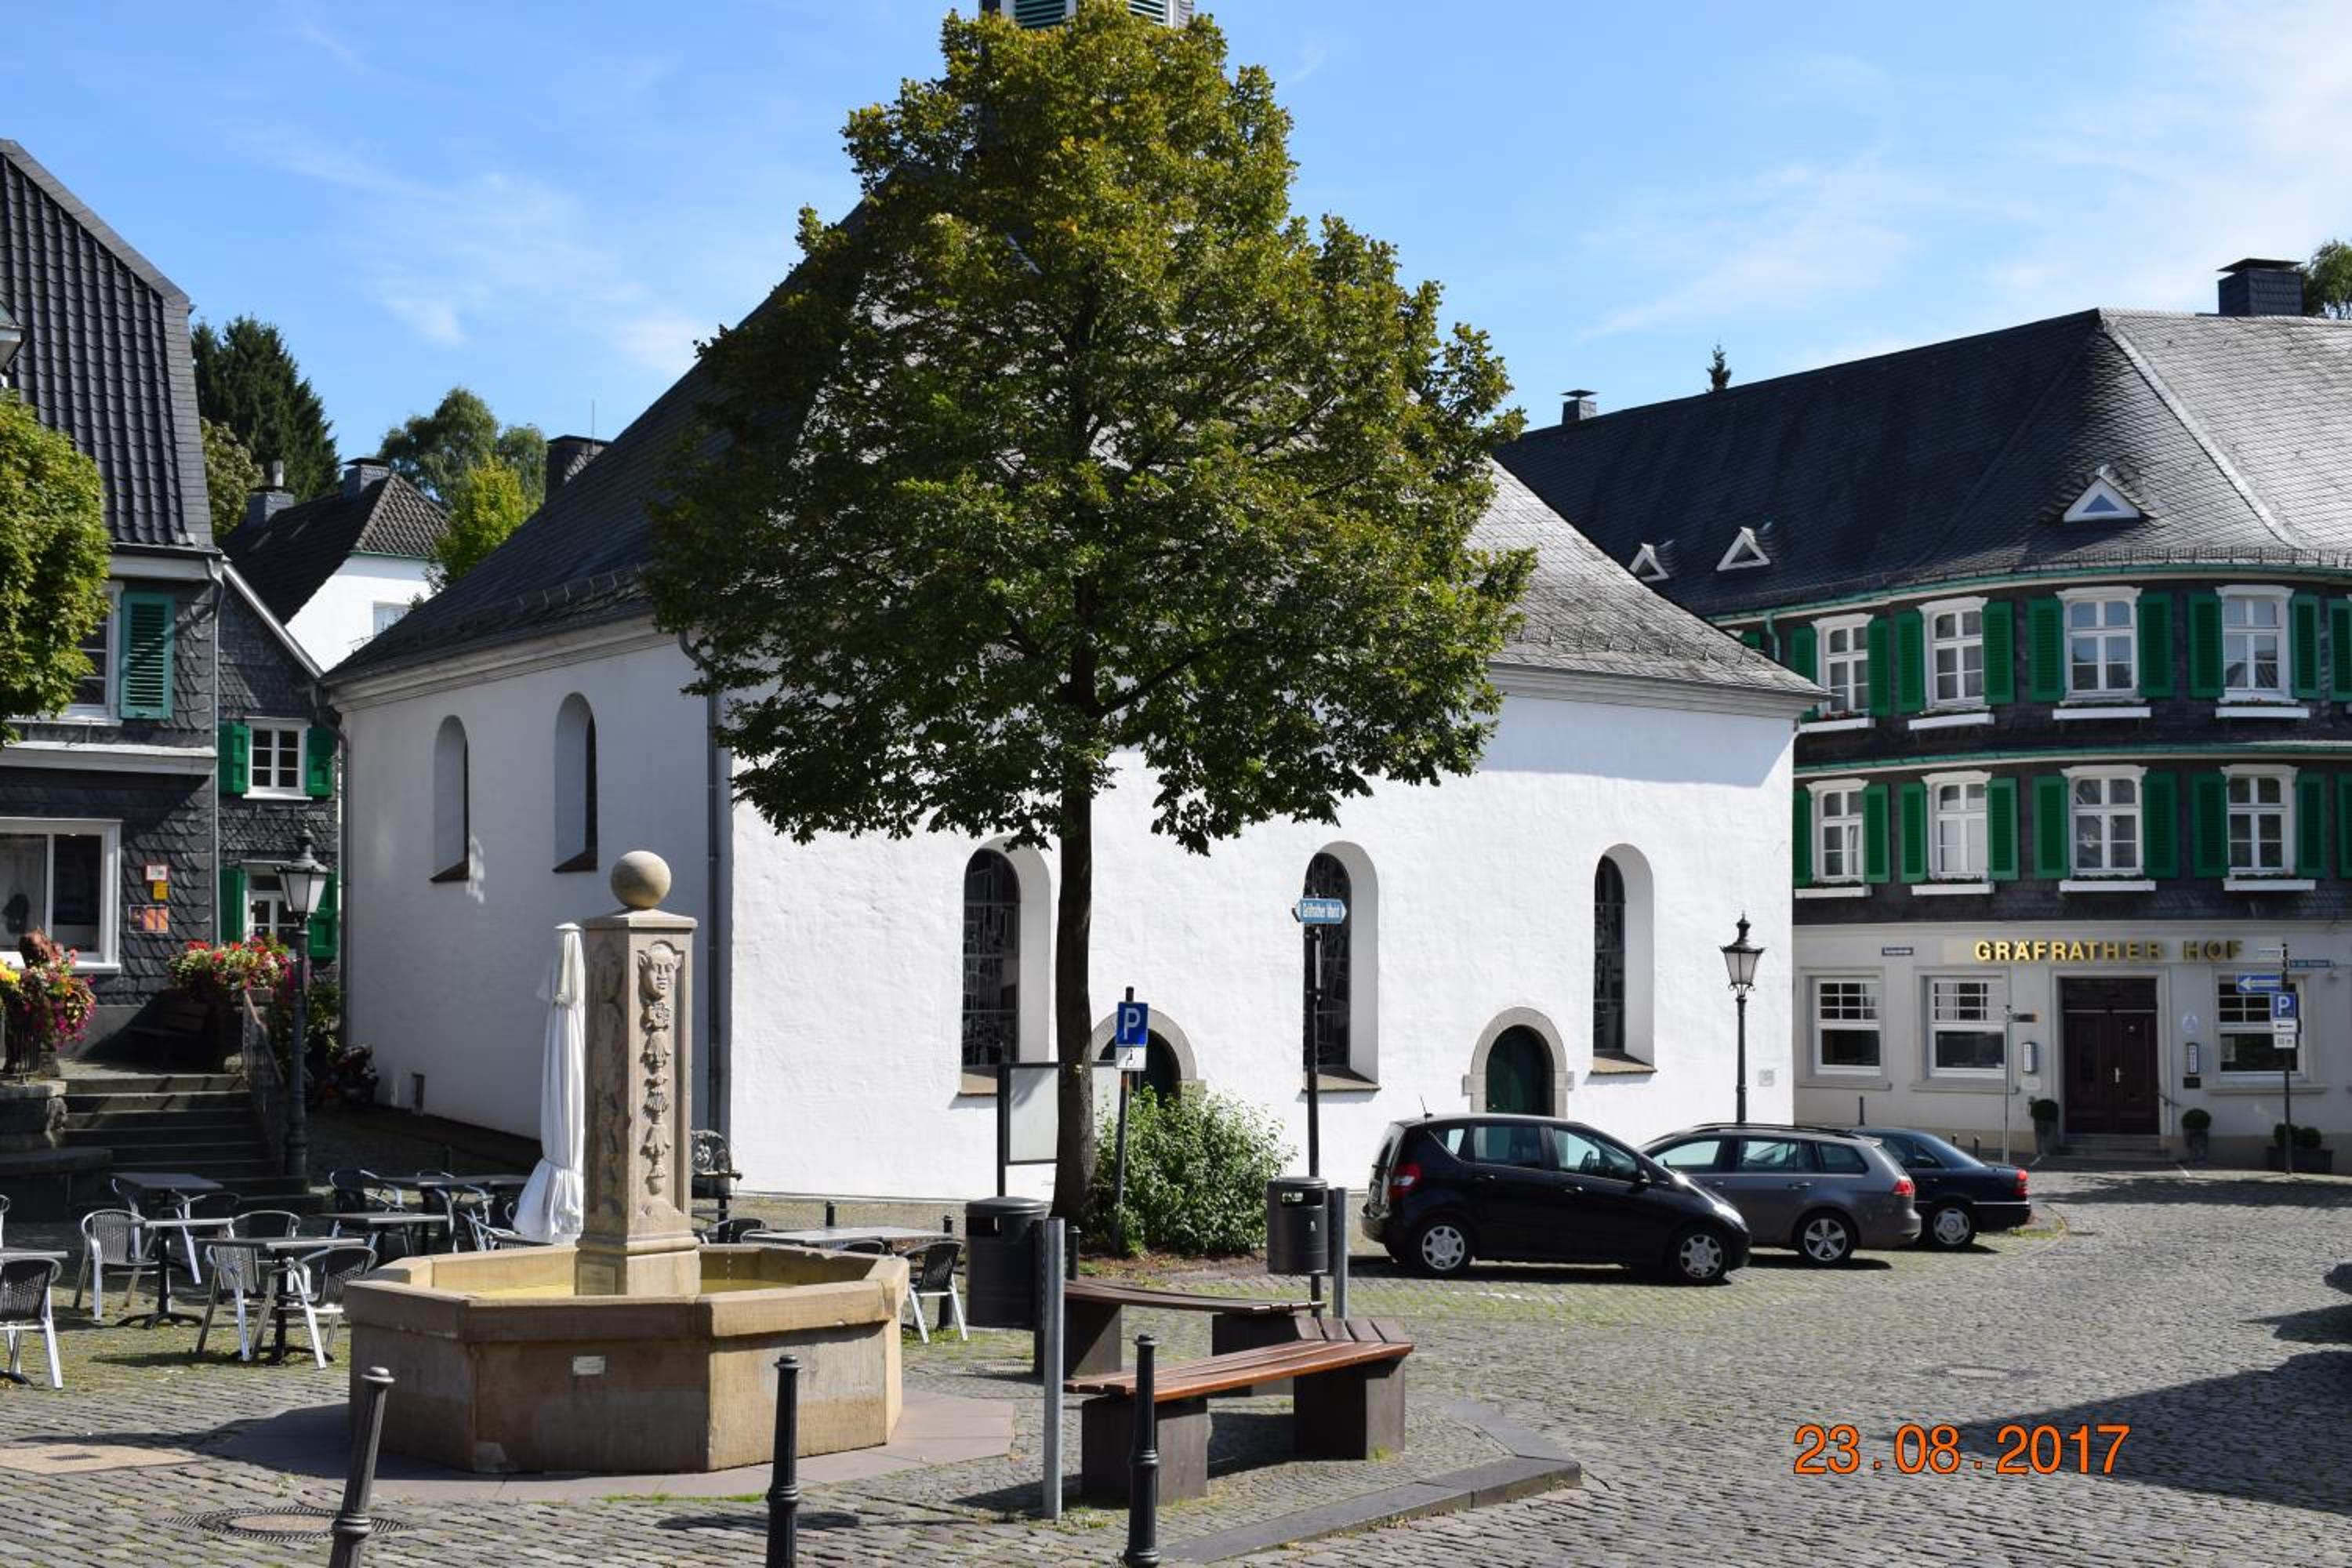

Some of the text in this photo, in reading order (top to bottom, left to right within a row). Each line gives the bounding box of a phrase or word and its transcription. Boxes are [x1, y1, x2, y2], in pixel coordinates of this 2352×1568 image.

[1974, 940, 2243, 961] GRÄFRATHER HOF
[2278, 996, 2291, 1015] P
[1123, 1007, 1141, 1040] P
